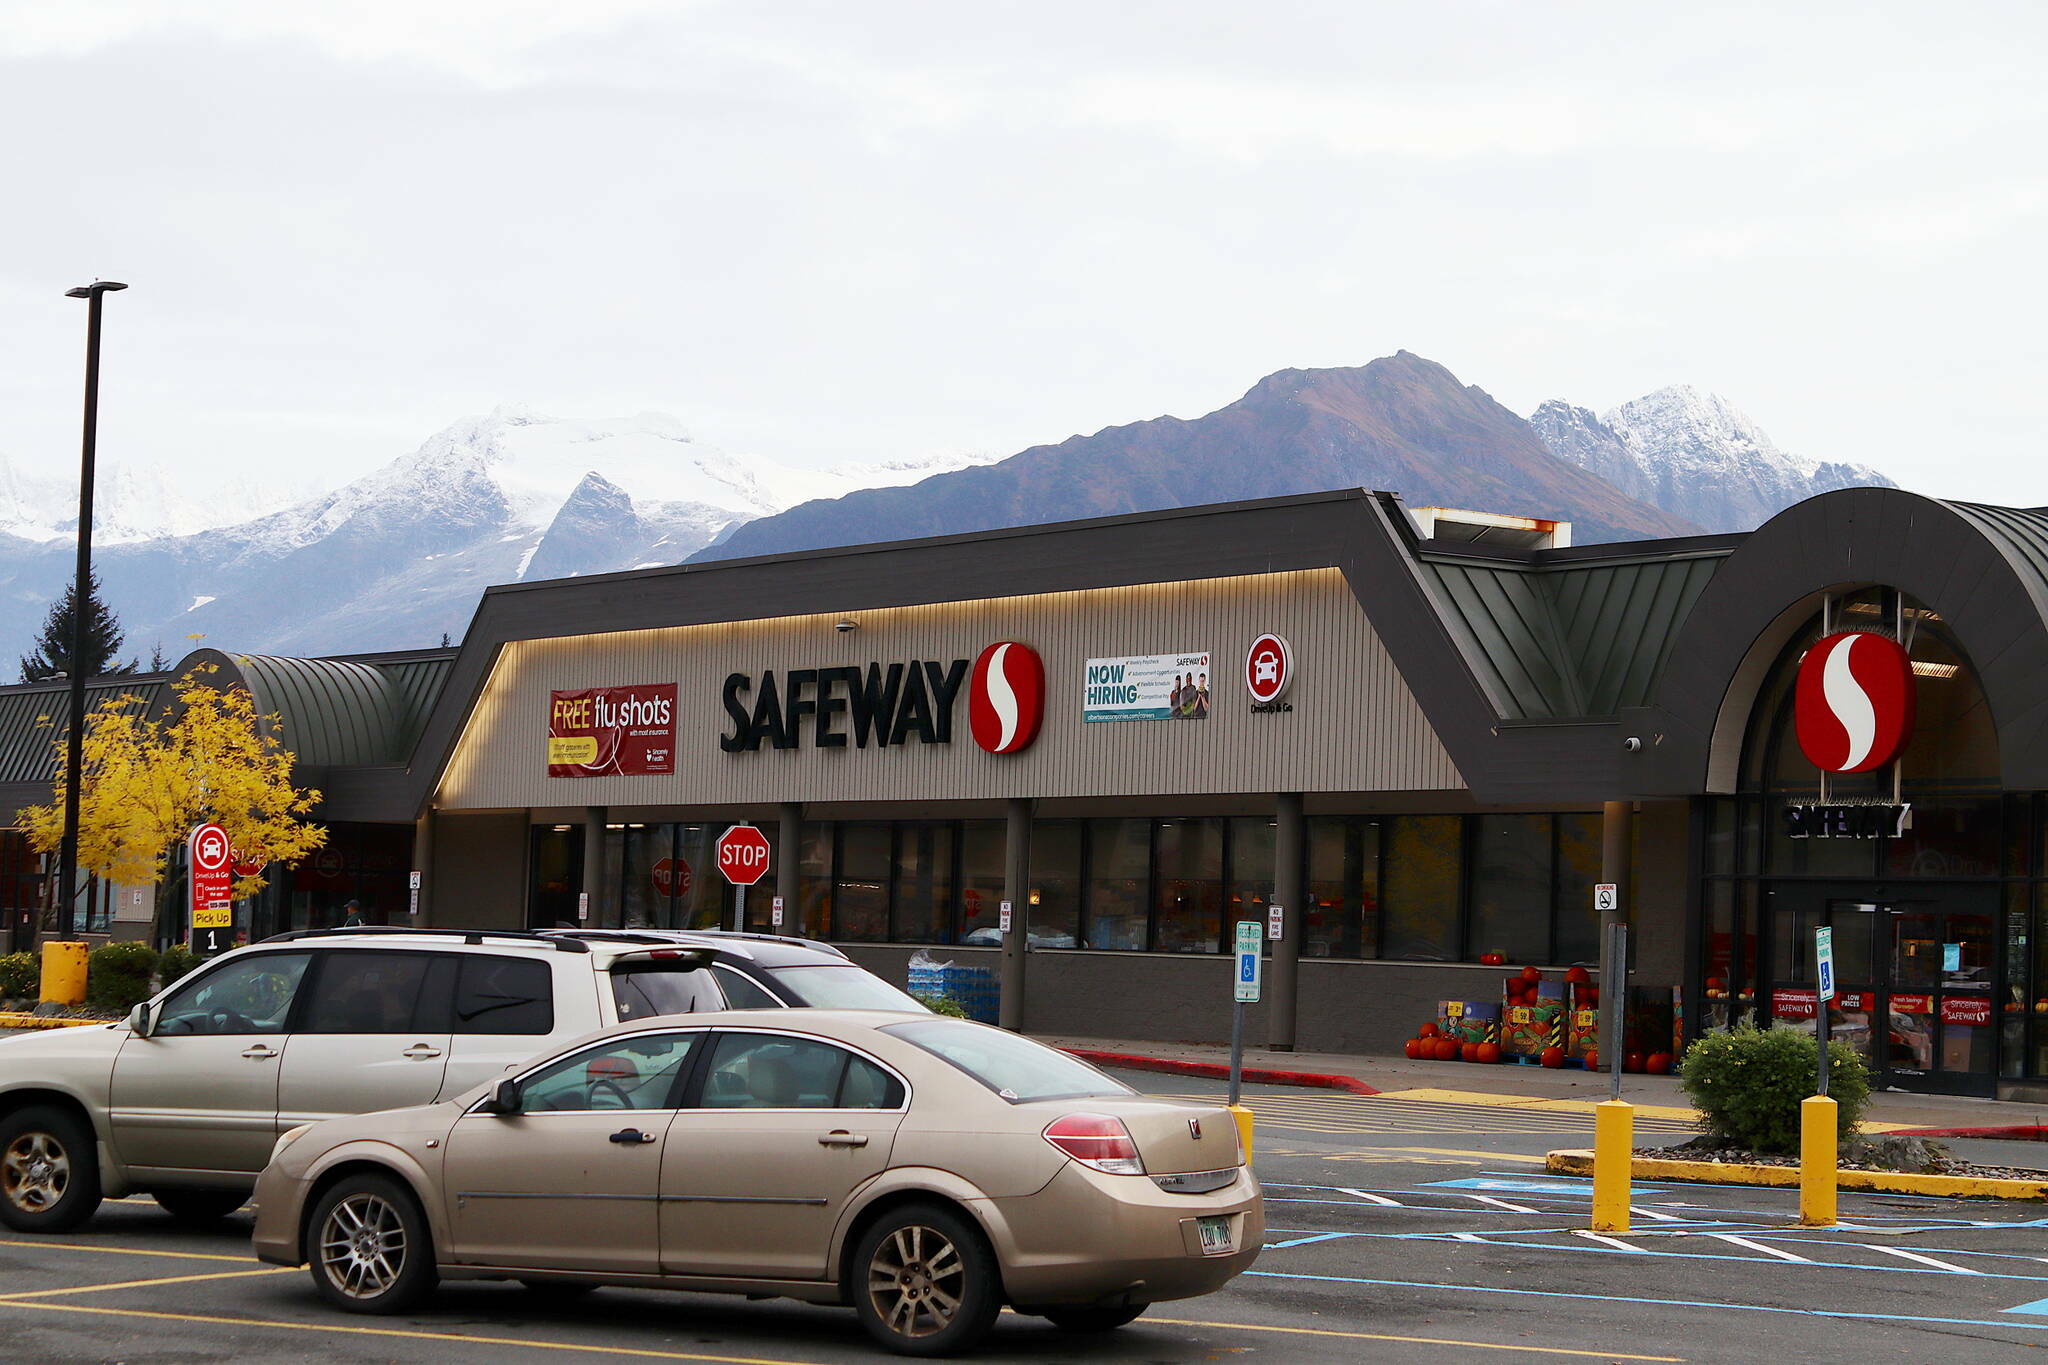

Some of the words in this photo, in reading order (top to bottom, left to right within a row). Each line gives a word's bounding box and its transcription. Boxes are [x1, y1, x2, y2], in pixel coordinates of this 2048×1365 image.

[1176, 657, 1200, 666] SAFEWAY
[1089, 665, 1125, 684] NOW
[1088, 685, 1137, 705] HIRING
[554, 698, 591, 729] FREE
[595, 695, 617, 728] flu
[720, 659, 970, 753] SAFEWAY
[1283, 702, 1293, 712] Go
[722, 843, 766, 867] STOP
[1033, 893, 1039, 903] 2
[196, 913, 213, 925] Pick
[217, 913, 229, 923] Up
[207, 930, 218, 950] 1
[1238, 940, 1259, 953] PARKING
[1778, 1003, 1804, 1012] SAFEWAY
[1841, 1000, 1860, 1008] PRICES
[1947, 1011, 1976, 1021] SAFEWAY
